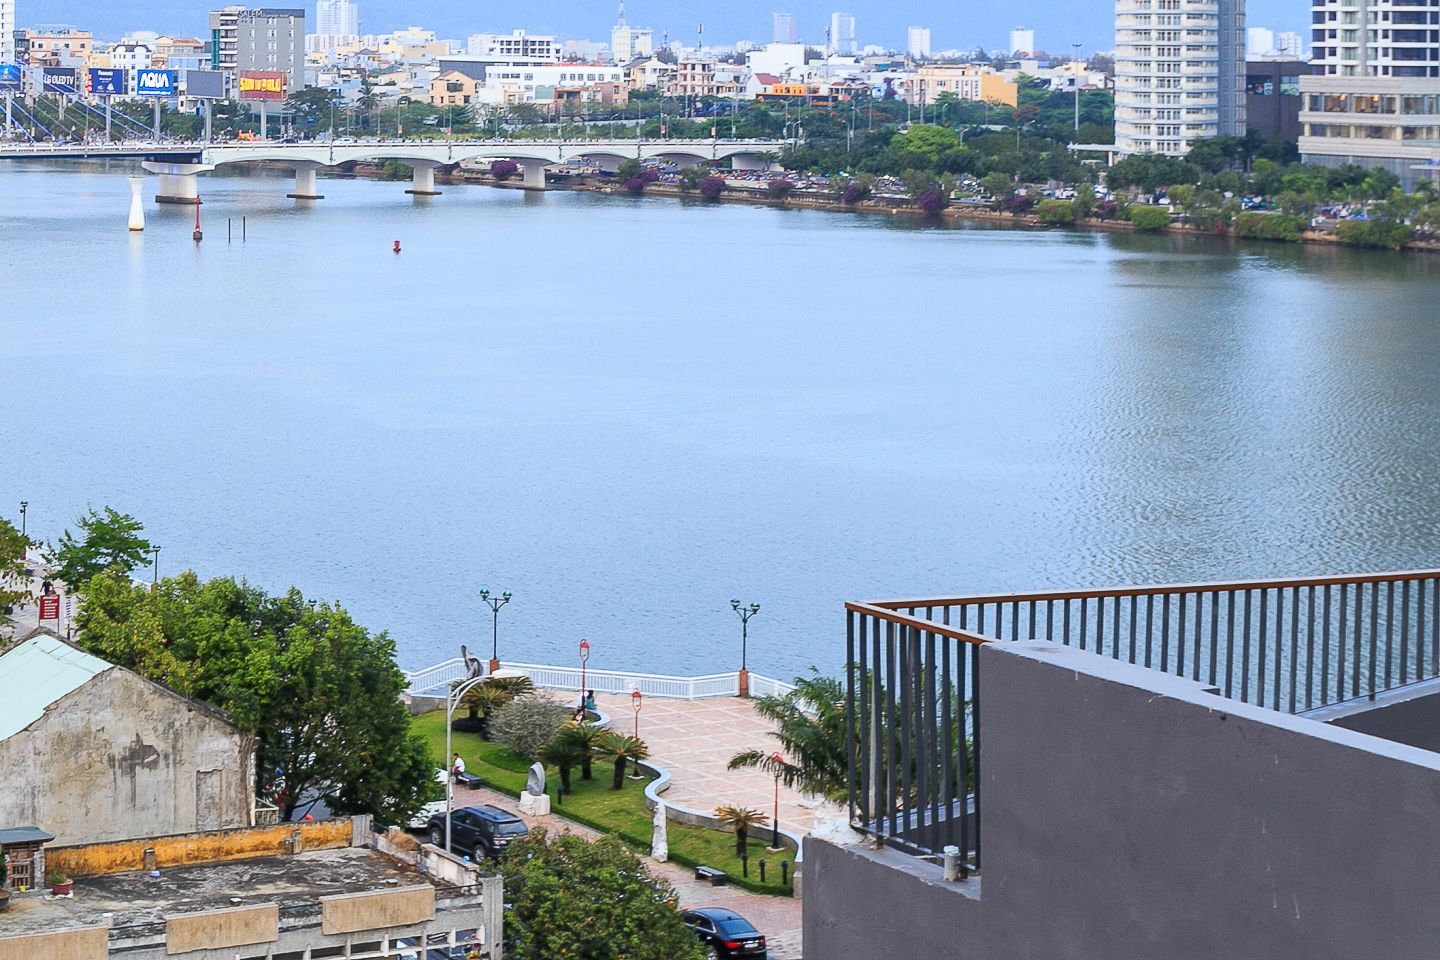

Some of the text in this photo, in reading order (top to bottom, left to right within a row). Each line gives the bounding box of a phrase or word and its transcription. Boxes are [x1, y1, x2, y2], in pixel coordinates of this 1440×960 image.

[44, 74, 74, 85] LG OLED TV
[140, 72, 169, 88] AQUA
